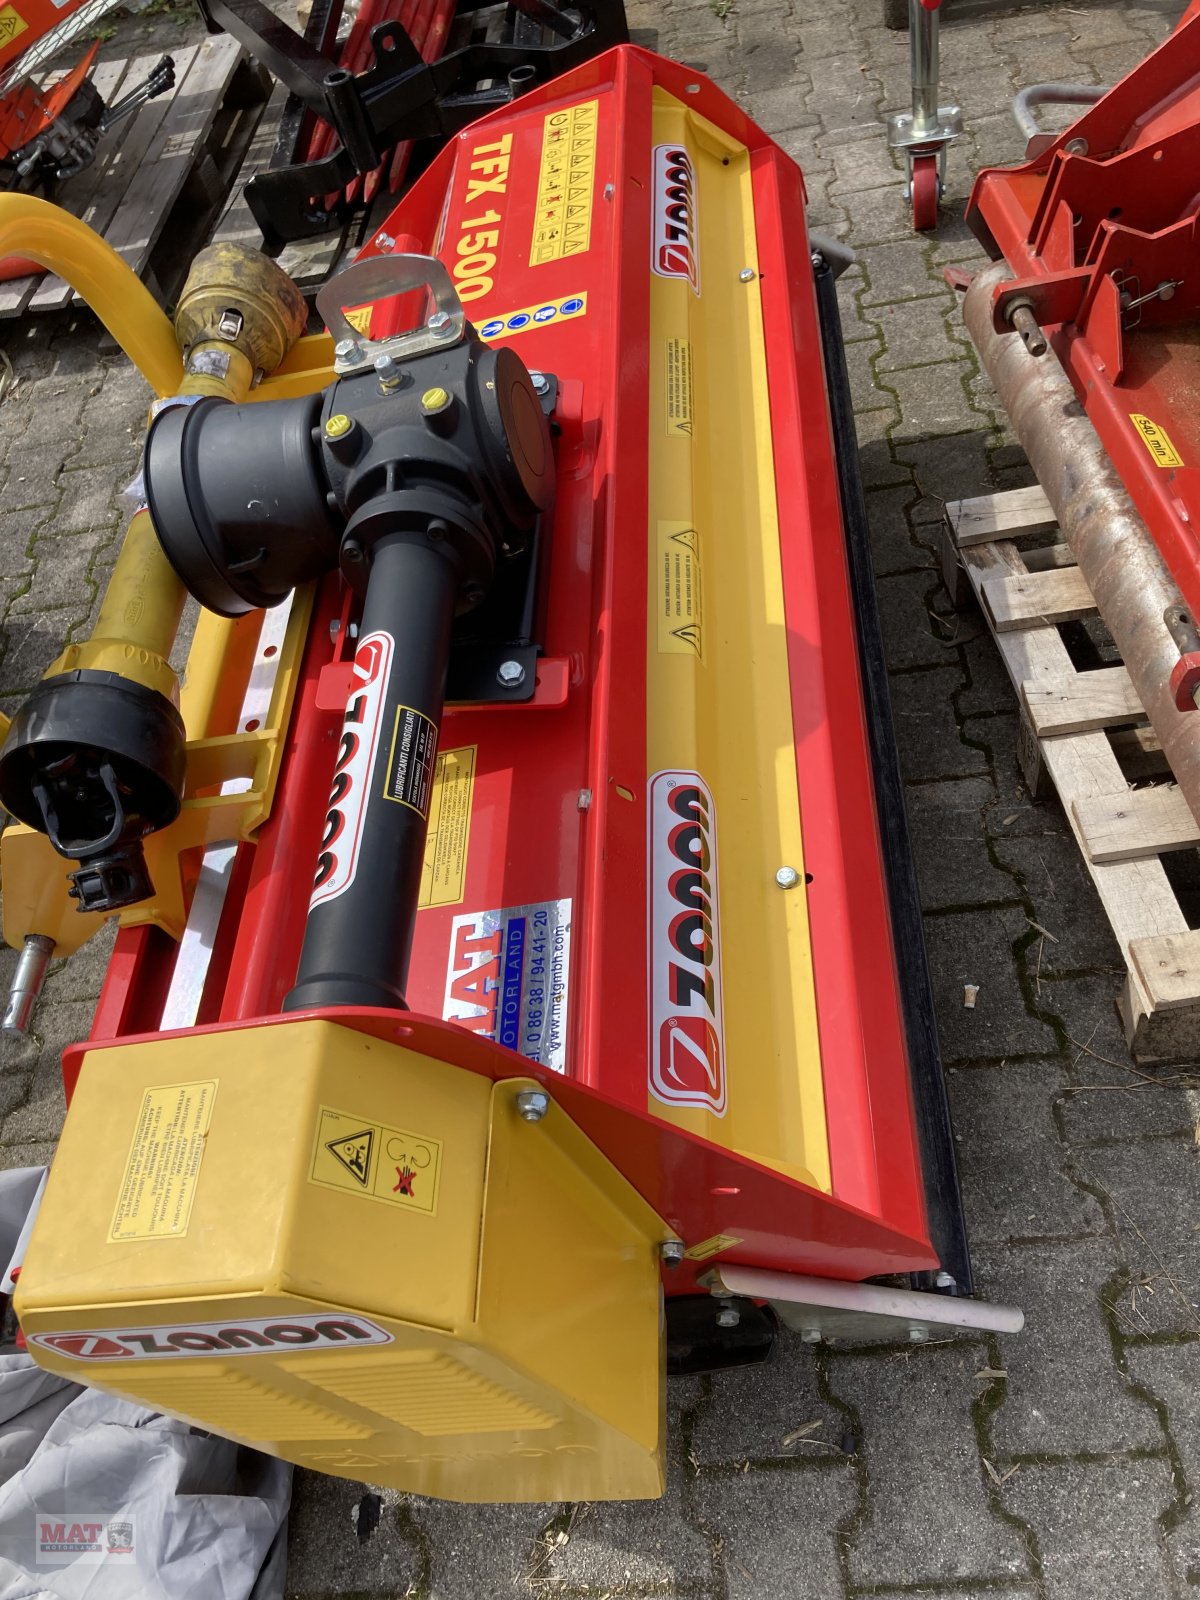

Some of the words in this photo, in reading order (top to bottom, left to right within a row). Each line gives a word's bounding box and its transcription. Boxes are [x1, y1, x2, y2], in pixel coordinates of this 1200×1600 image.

[466, 133, 512, 202] TFX
[454, 210, 502, 302] 1500
[1140, 420, 1156, 435] 540
[1150, 440, 1165, 456] min
[401, 711, 414, 751] CONSIGLIATI
[394, 752, 409, 799] LUBRIFICANTI
[667, 784, 715, 1018] zanon
[531, 957, 545, 974] 94
[502, 930, 522, 1046] OTORLAND
[529, 988, 544, 1006] 38
[549, 925, 564, 1052] www.matgmbh.com
[528, 1009, 543, 1027] 86
[526, 1033, 541, 1042] 0
[526, 1047, 541, 1063] el.
[179, 1098, 191, 1134] MANTENER
[193, 1089, 207, 1130] MANTENERE
[170, 1130, 176, 1139] LA
[143, 1140, 155, 1171] MACHINE
[170, 1136, 183, 1176] LUBRICADA
[183, 1132, 198, 1176] LUBRIFICATA
[132, 1172, 148, 1217] LUBRICATED
[168, 1177, 175, 1187] LA
[181, 1177, 188, 1187] LA
[118, 1321, 373, 1353] zanon
